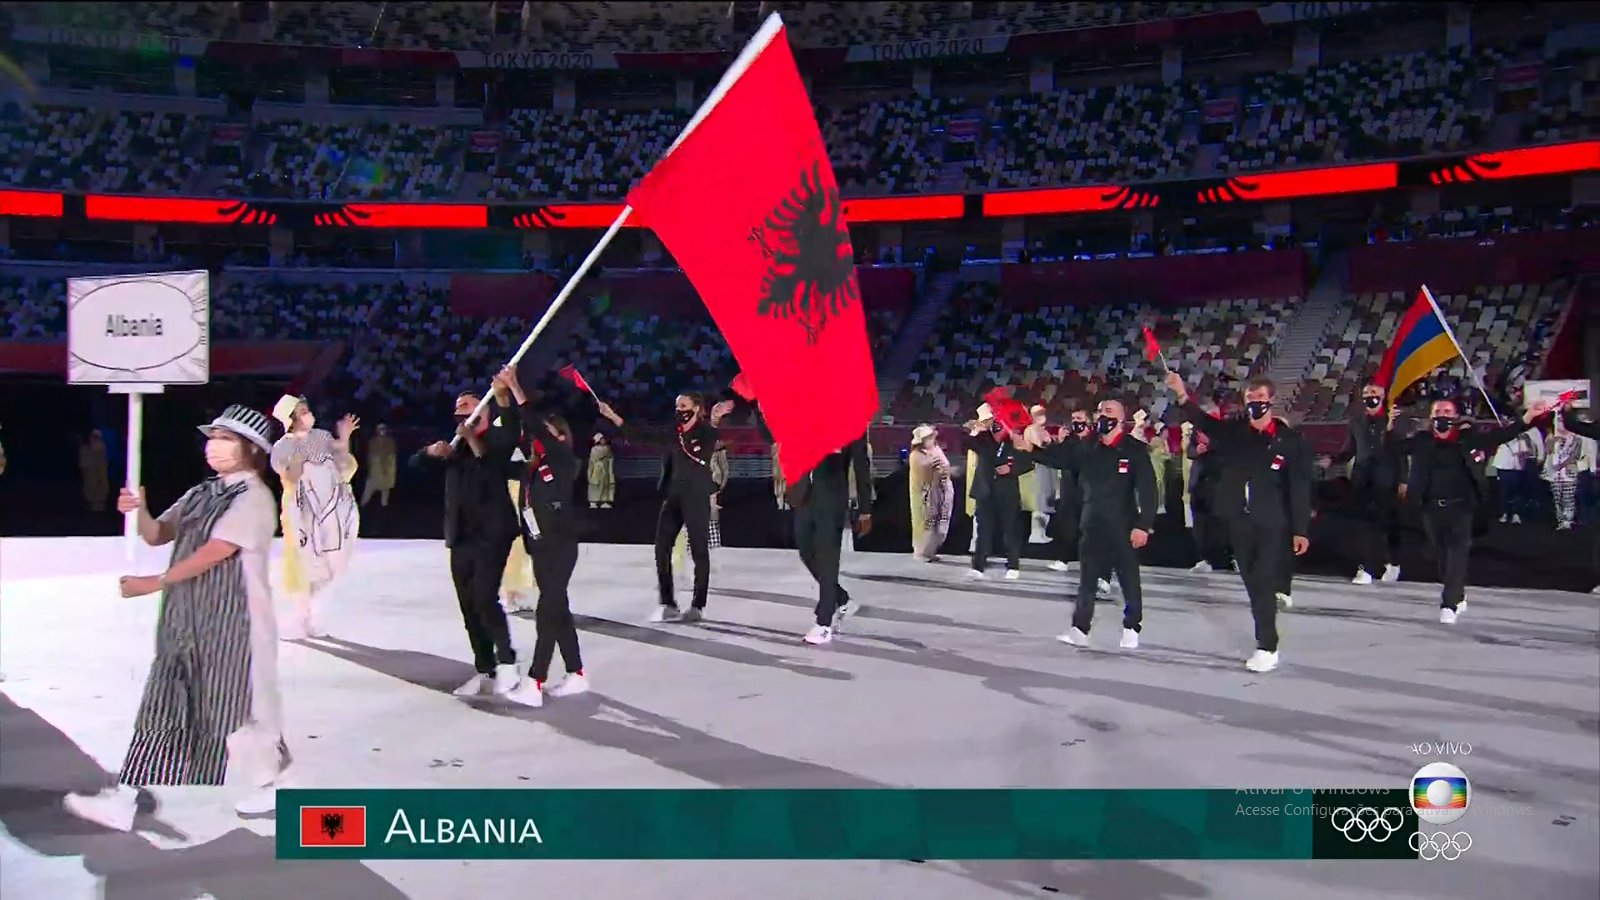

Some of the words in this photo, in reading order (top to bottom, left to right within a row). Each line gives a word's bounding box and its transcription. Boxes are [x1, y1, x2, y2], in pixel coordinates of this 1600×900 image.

[481, 51, 544, 70] TOKYO
[549, 52, 593, 71] 2020
[871, 42, 931, 61] TOKYO
[937, 38, 983, 57] 2020
[105, 313, 163, 338] Albania
